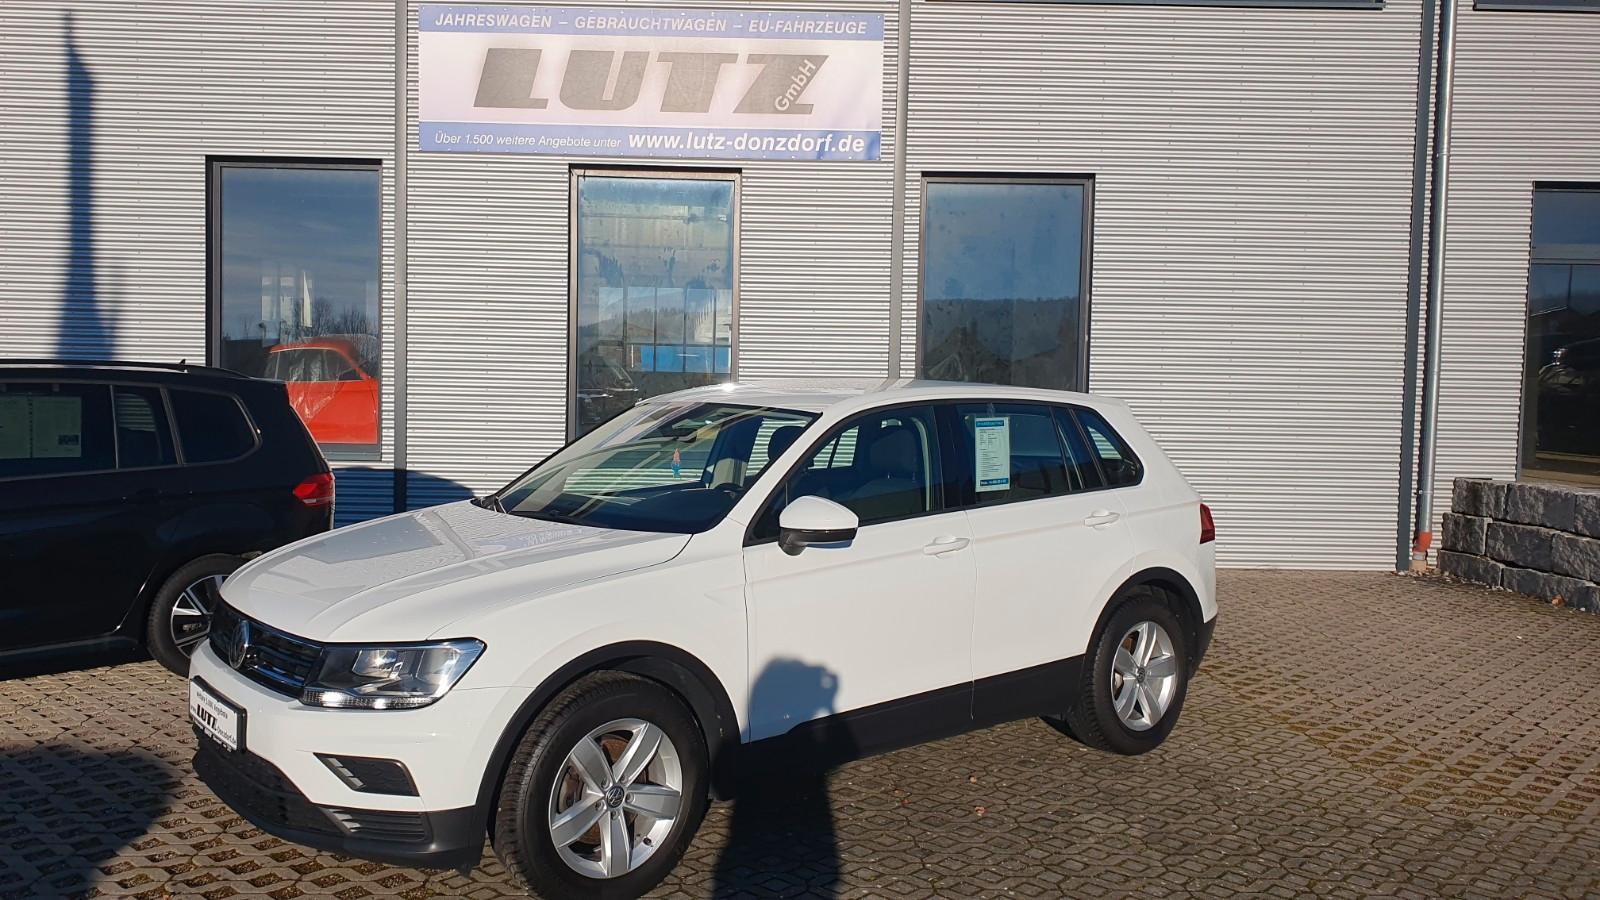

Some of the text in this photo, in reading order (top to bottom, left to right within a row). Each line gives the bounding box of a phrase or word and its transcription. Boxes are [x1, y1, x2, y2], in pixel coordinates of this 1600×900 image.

[435, 13, 552, 28] JAHRESWAGEN
[575, 16, 727, 32] GEBRAUCHTWAGEN
[748, 19, 868, 34] EU-FAHRZEUGE
[473, 47, 829, 115] LUTZ
[774, 59, 817, 113] GmbH
[435, 130, 865, 153] Über 1.500 weitere Angebote unter www.lutz-donzdorf.de
